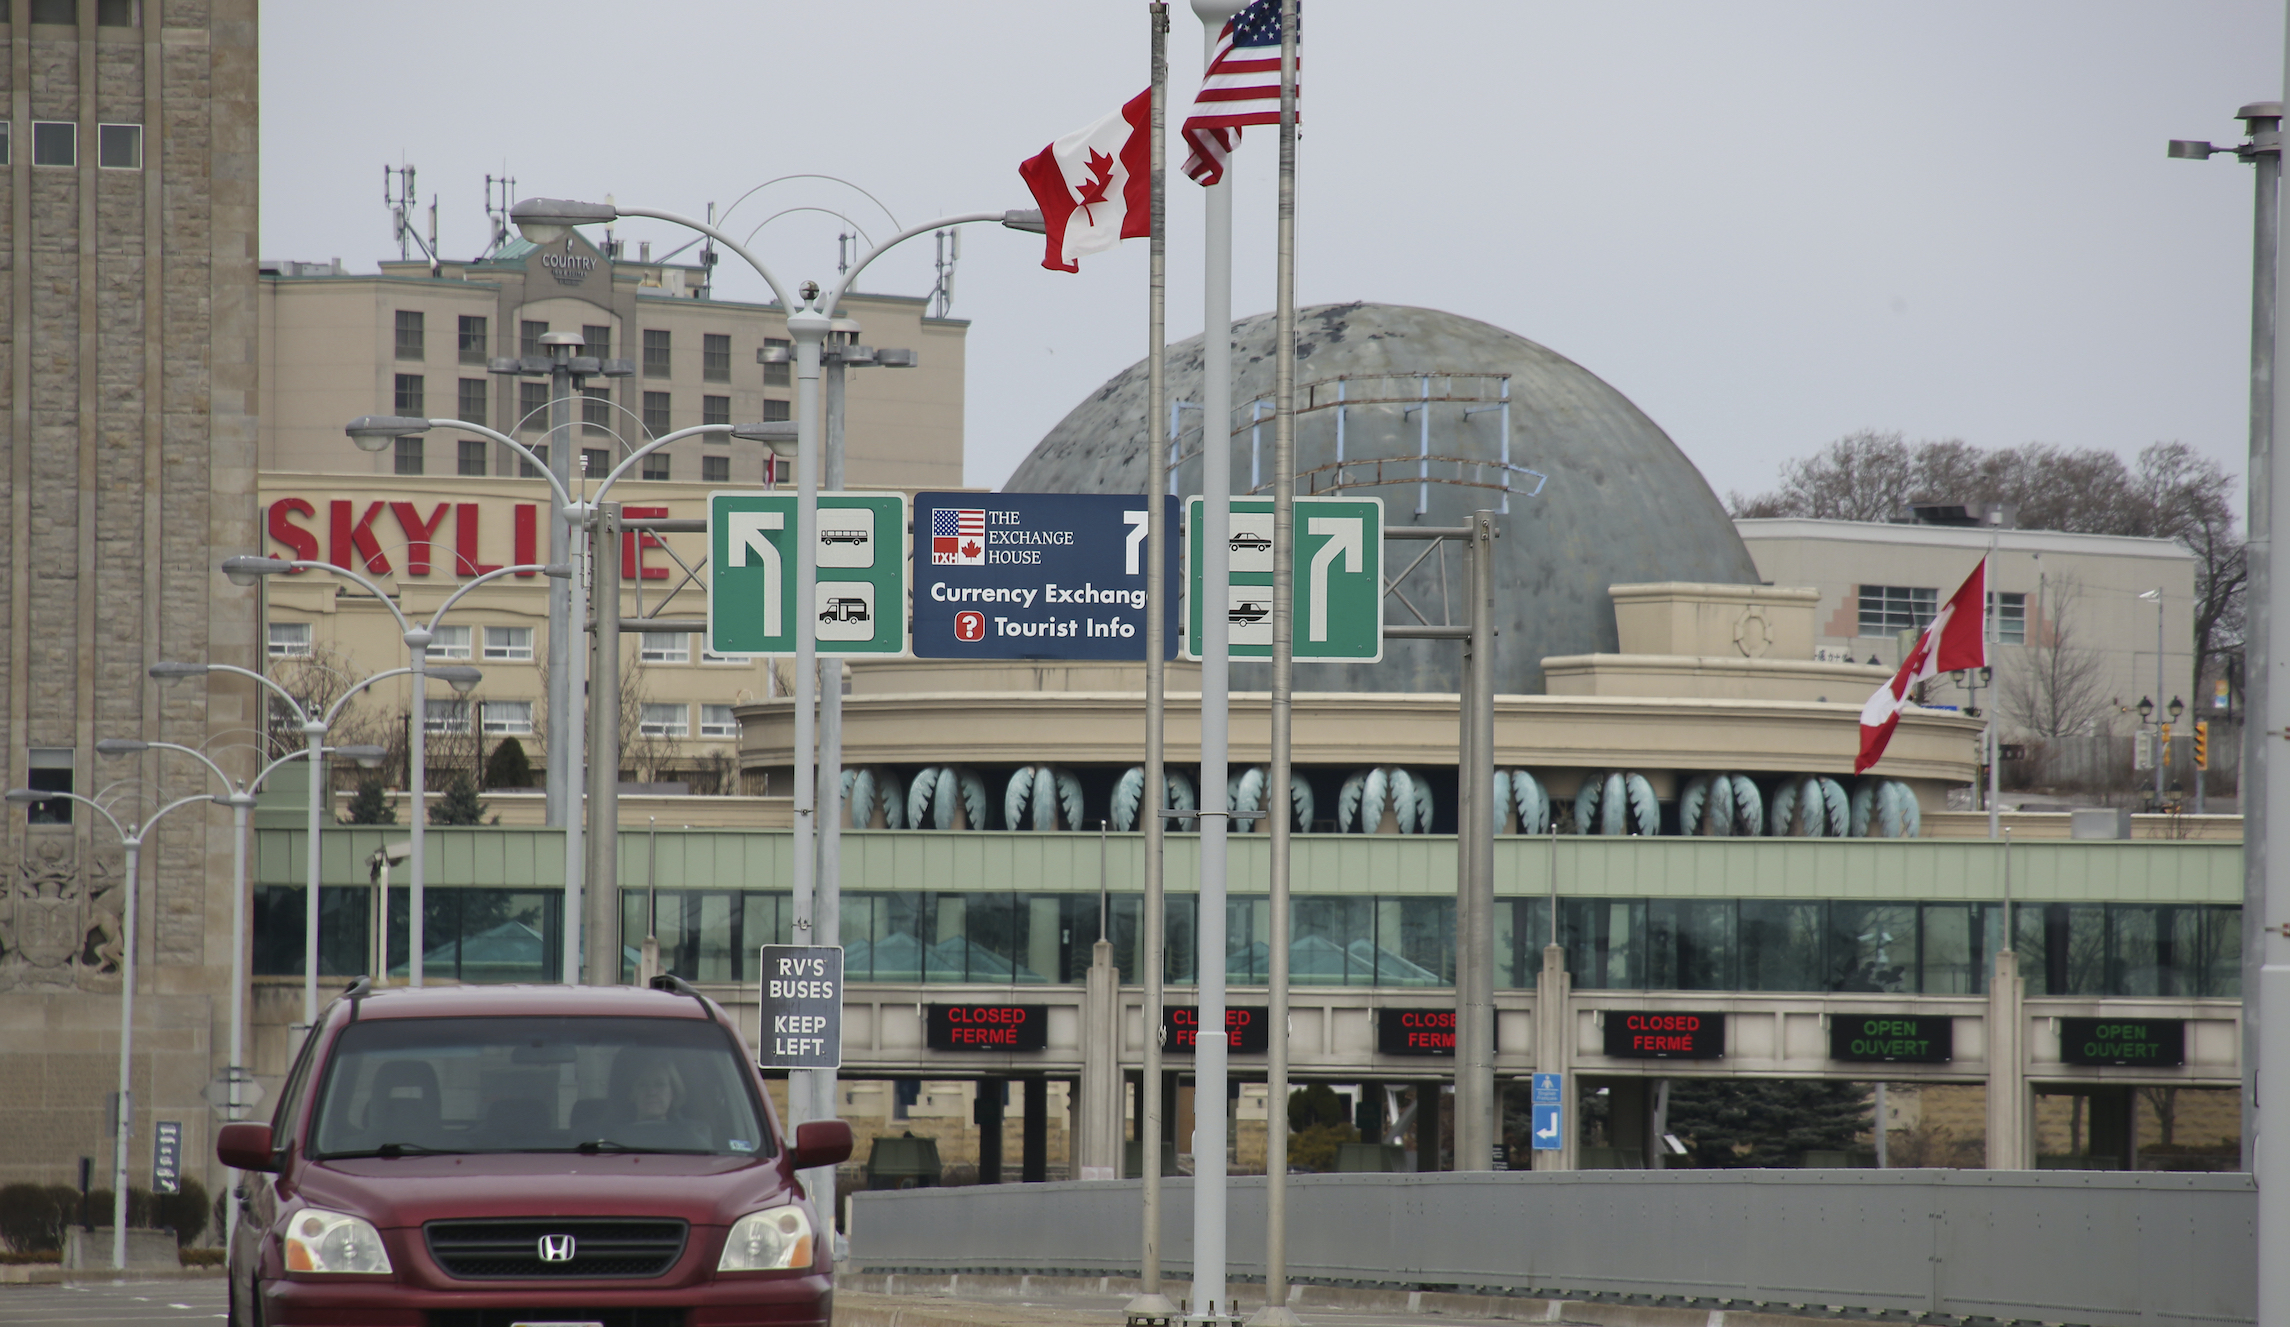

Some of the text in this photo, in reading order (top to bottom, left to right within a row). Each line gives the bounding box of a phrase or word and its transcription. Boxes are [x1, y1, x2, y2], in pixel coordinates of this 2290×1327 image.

[988, 510, 1021, 525] THE
[268, 497, 670, 579] SKYLIE
[988, 530, 1074, 545] EXCHANGE
[933, 552, 959, 565] TXH
[988, 550, 1042, 565] HOUSE
[930, 581, 1148, 610] Currency Exchang
[994, 616, 1078, 638] Tourist
[1086, 616, 1136, 638] Info
[779, 958, 825, 977] RV'S
[769, 980, 834, 999] BUSES
[774, 1015, 827, 1034] KEEP
[948, 1008, 1027, 1024] CLOSED
[1173, 1009, 1251, 1026] CLED
[1401, 1012, 1457, 1028] CLOSE
[1626, 1015, 1700, 1032] CLOSED
[951, 1024, 1018, 1045] FERMÉ
[1176, 1026, 1243, 1047] FEÉ
[1863, 1020, 1918, 1036] OPEN
[2095, 1024, 2147, 1040] OPEN
[776, 1038, 825, 1056] LEFT
[1408, 1032, 1457, 1048] FERM
[1633, 1034, 1693, 1052] FERMÉ
[1850, 1039, 1930, 1056] OUVERT
[2083, 1041, 2160, 1058] OUVERT
